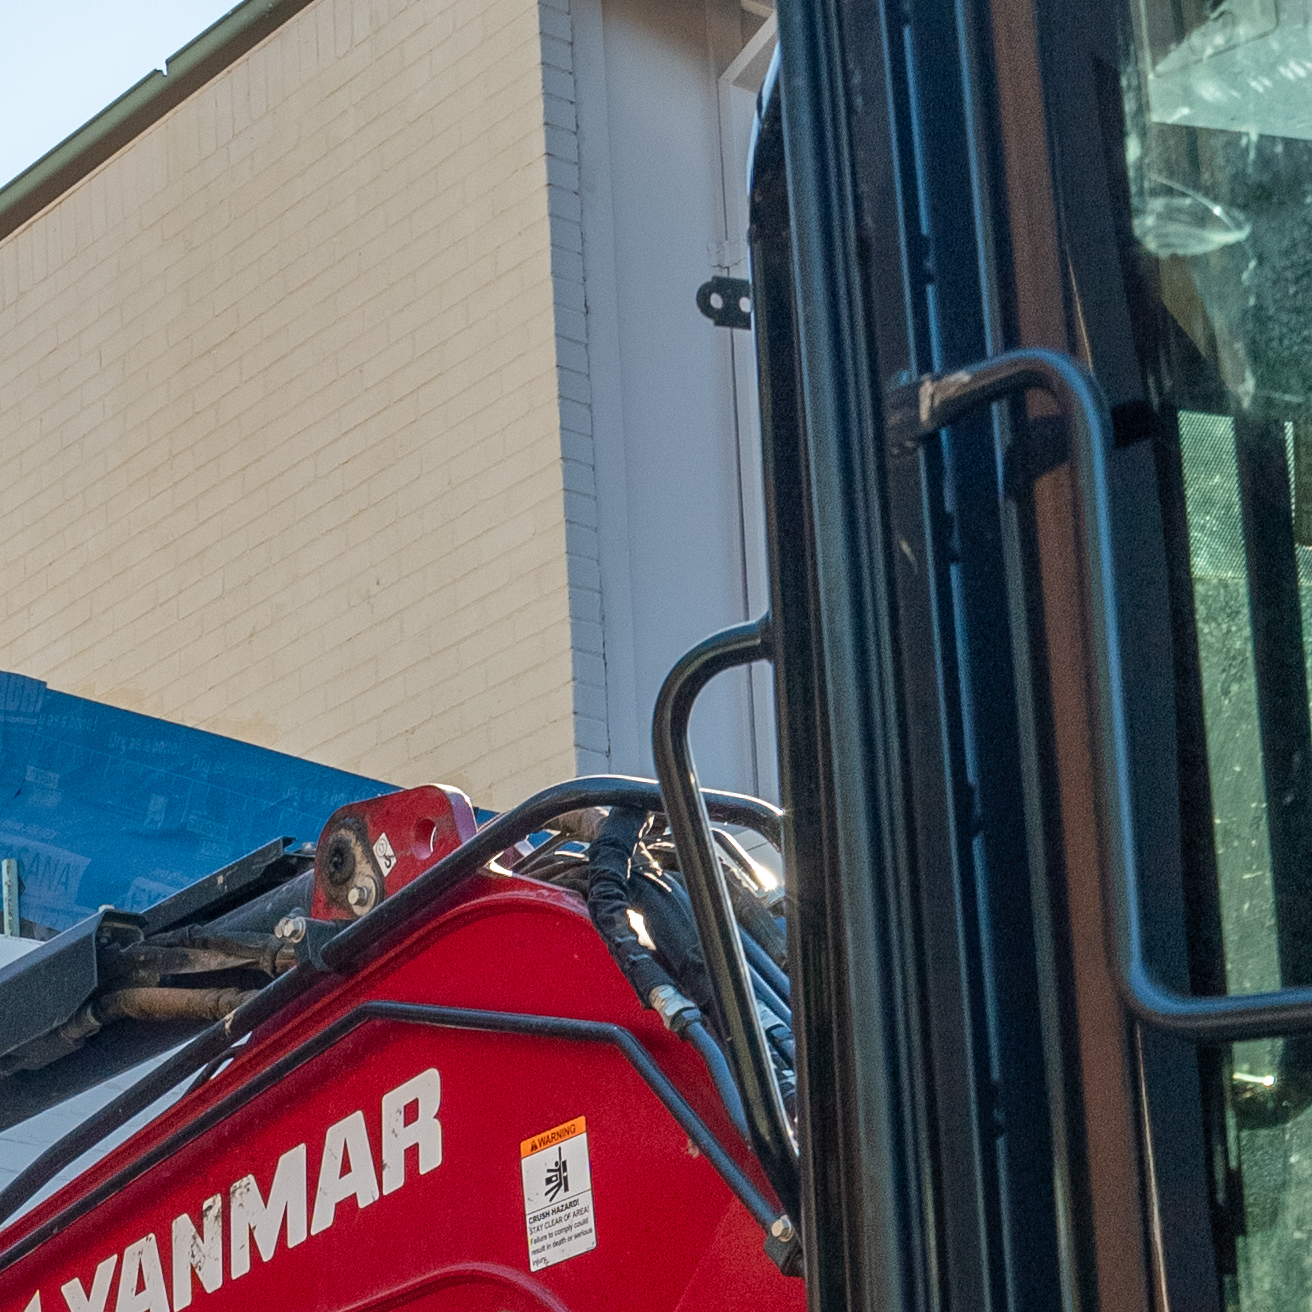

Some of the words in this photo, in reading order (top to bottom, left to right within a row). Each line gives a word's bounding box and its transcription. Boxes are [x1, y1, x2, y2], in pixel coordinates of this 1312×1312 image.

[537, 1123, 576, 1148] WARNING
[528, 1210, 550, 1225] CRUSH
[551, 1198, 580, 1216] HAZARD!
[529, 1222, 544, 1235] STAY
[544, 1216, 563, 1230] CLEAR
[564, 1212, 572, 1222] OF
[572, 1204, 590, 1220] AREA!
[530, 1231, 548, 1245] Failure
[554, 1224, 573, 1238] comply
[574, 1216, 589, 1230] could
[531, 1243, 546, 1256] result
[552, 1235, 567, 1249] death
[574, 1227, 593, 1242] serious
